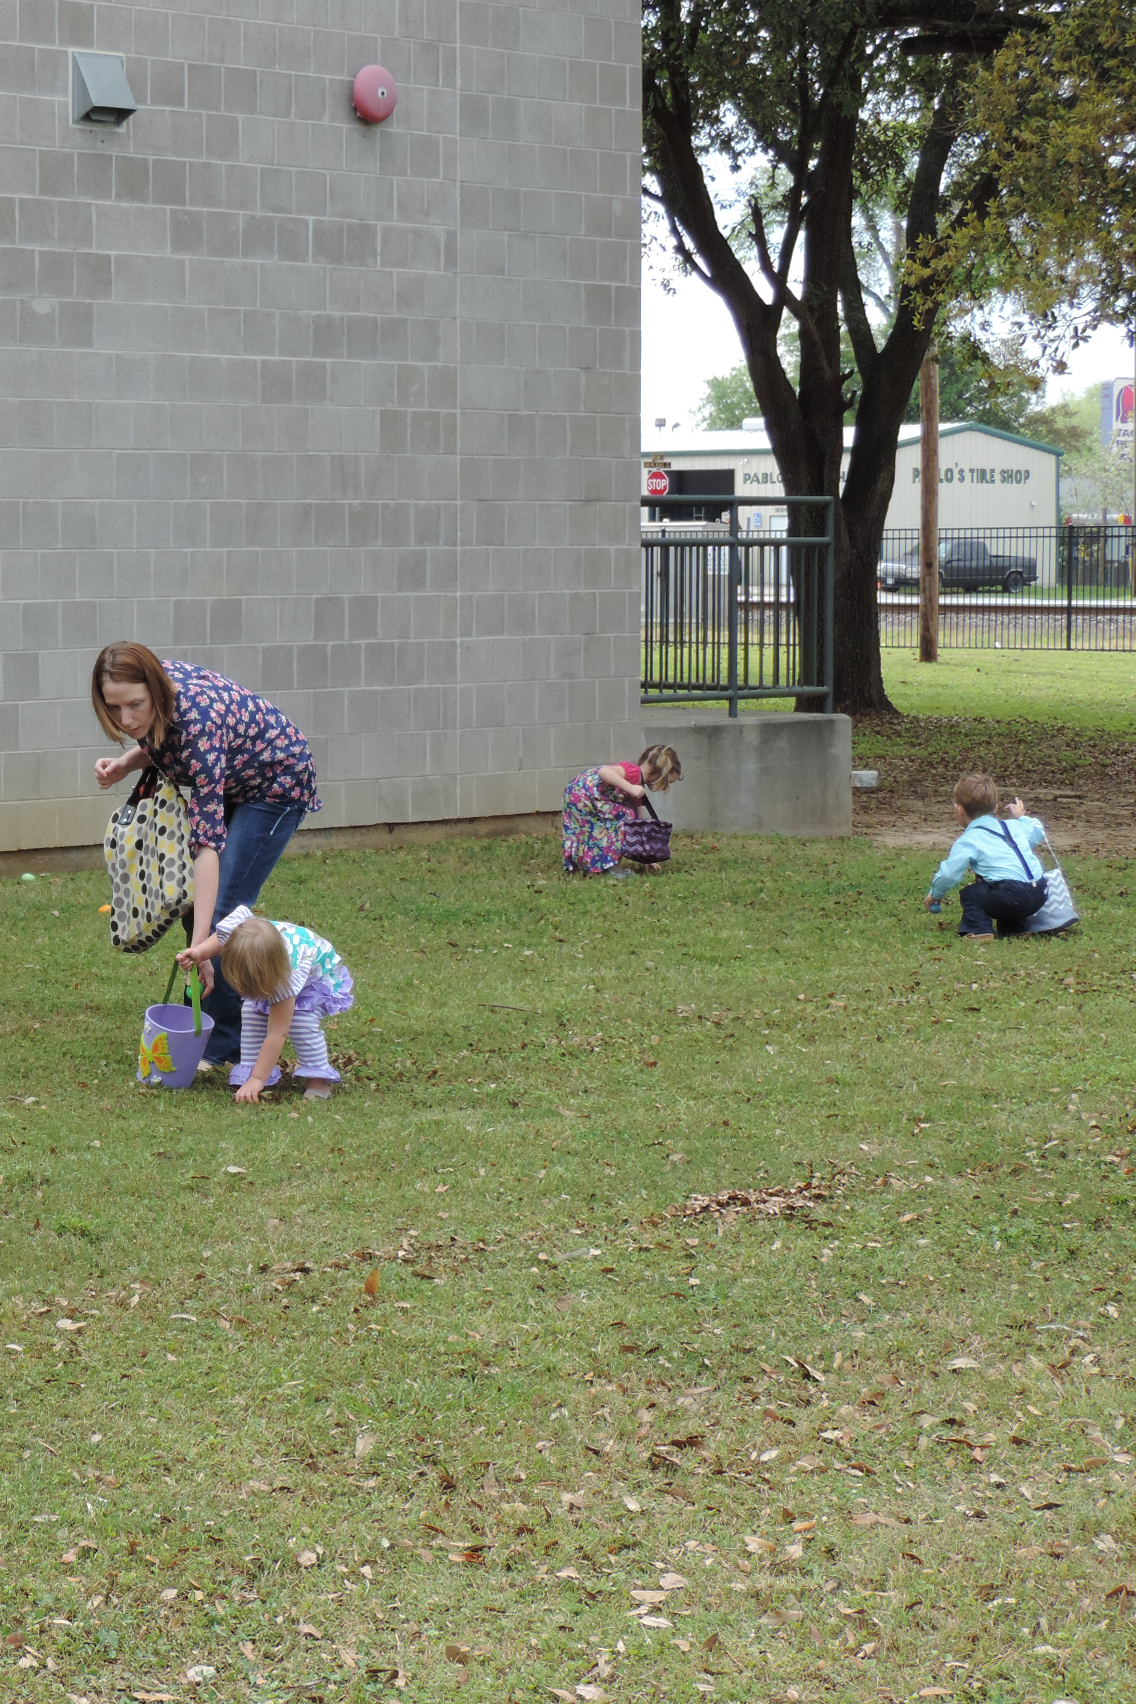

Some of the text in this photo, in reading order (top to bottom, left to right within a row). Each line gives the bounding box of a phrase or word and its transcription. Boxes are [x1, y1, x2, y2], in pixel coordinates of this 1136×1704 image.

[912, 463, 1030, 485] PLO'S TIRE SHOP
[648, 479, 667, 490] STOP
